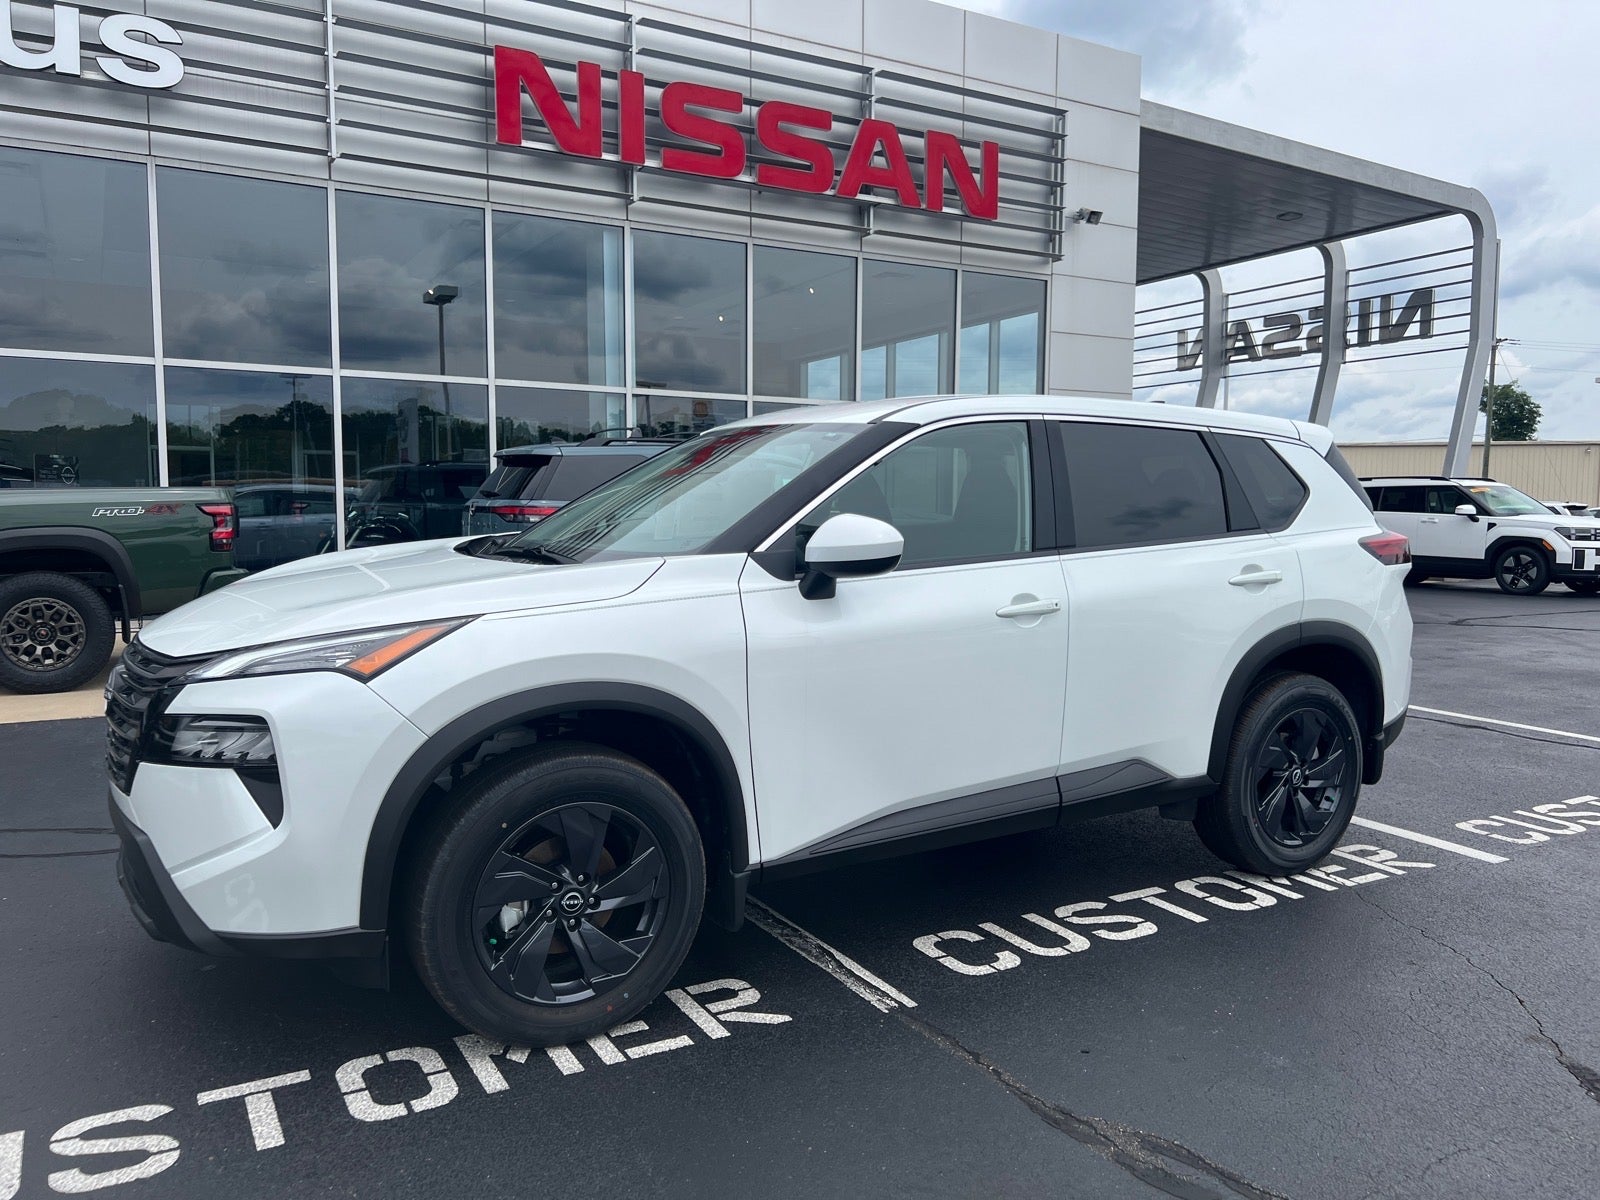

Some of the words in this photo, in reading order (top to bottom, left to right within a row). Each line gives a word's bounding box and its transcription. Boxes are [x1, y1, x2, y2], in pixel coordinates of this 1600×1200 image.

[494, 44, 999, 220] NISSAN
[912, 844, 1437, 976] CUSTOMER
[0, 978, 793, 1200] STOMER
